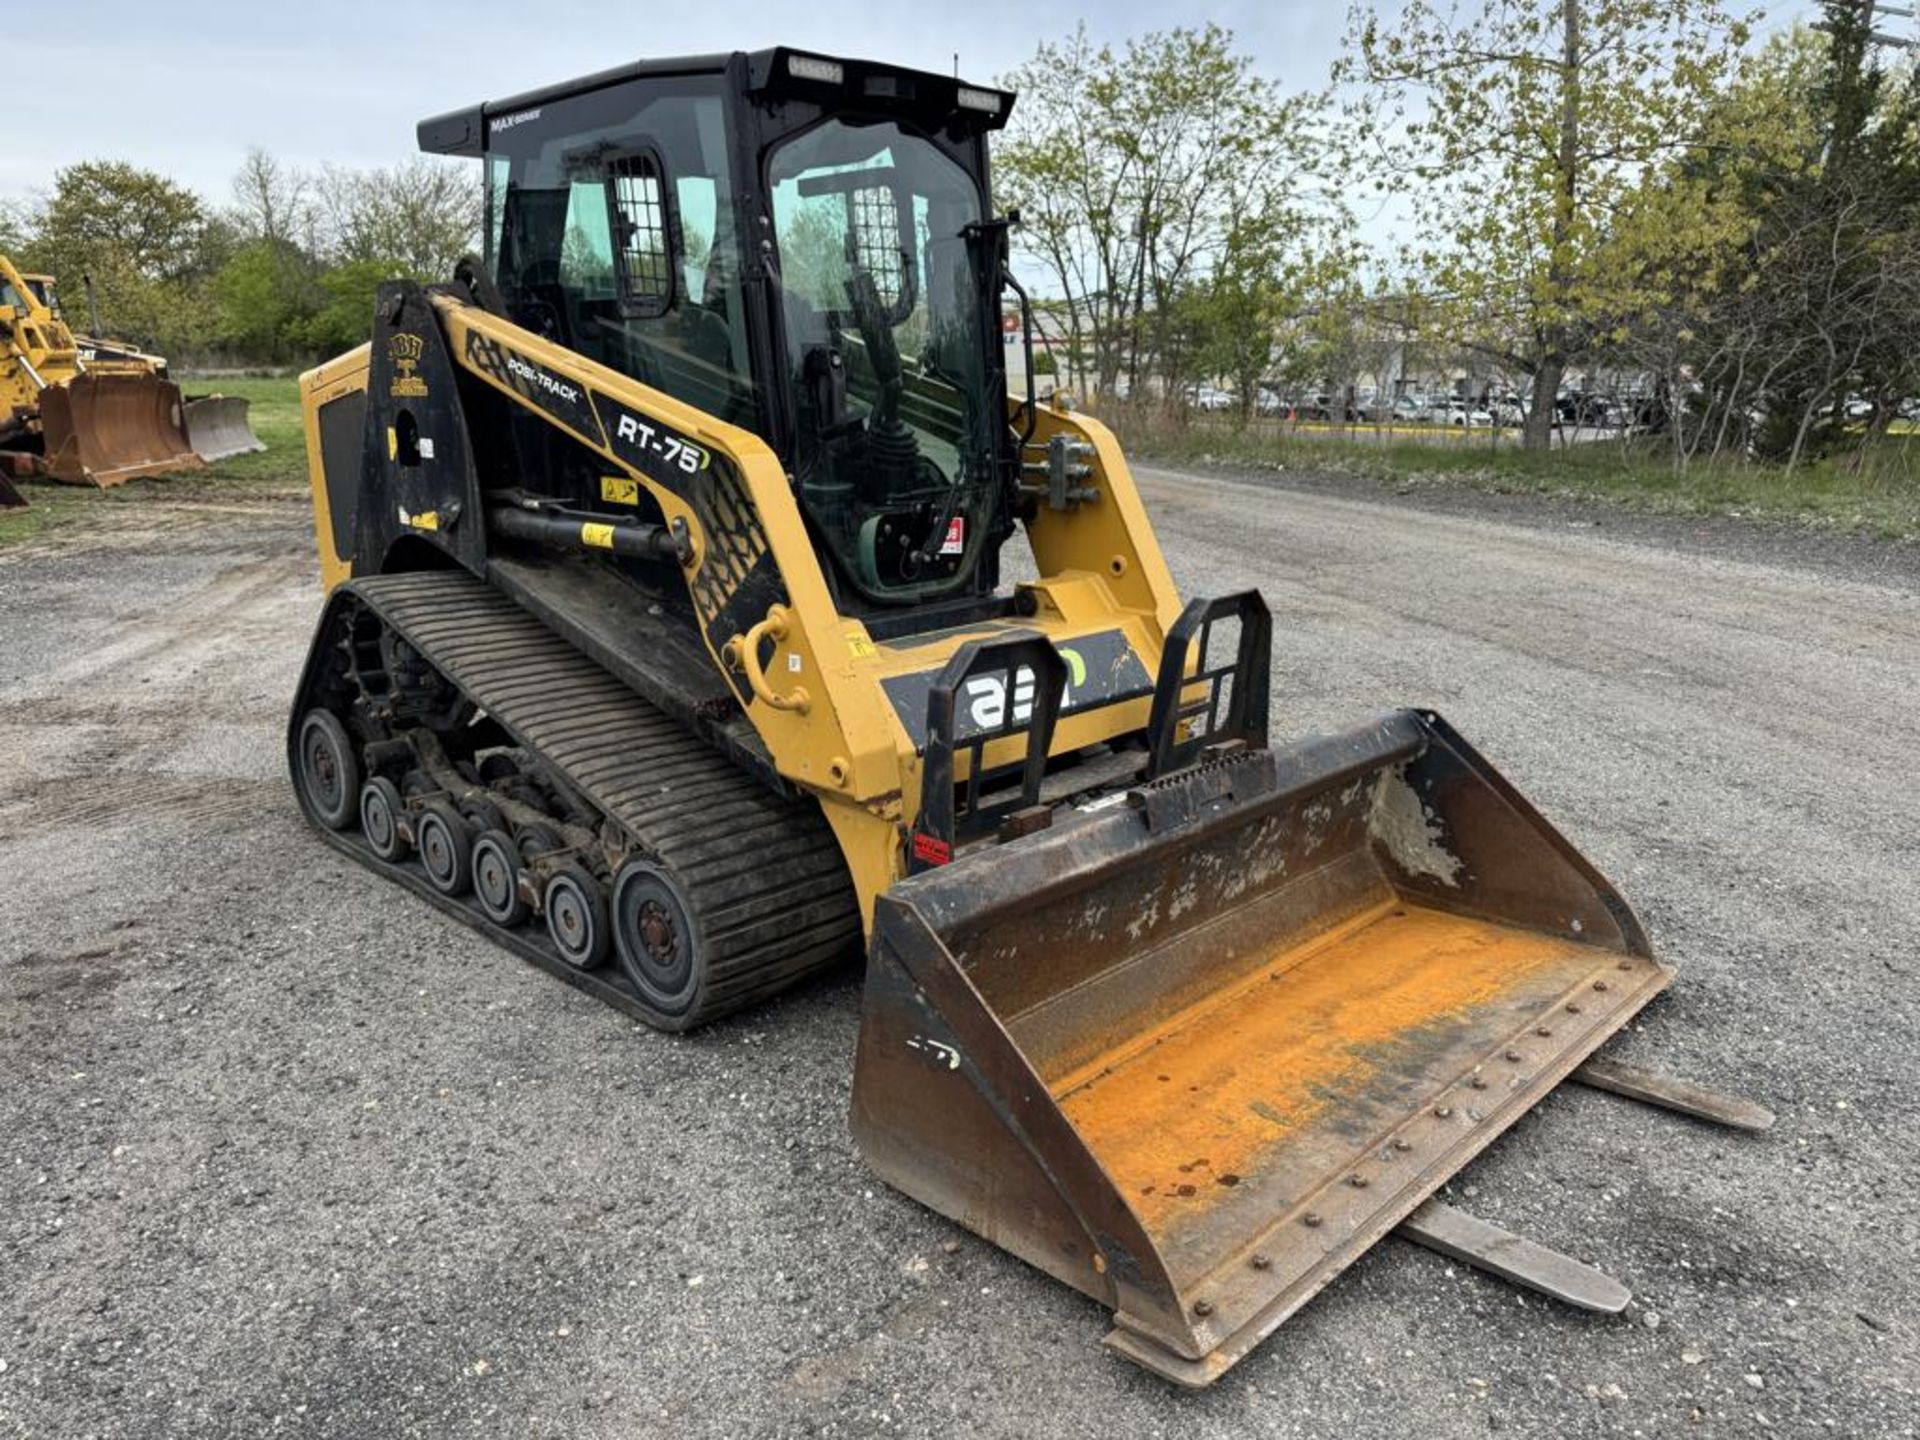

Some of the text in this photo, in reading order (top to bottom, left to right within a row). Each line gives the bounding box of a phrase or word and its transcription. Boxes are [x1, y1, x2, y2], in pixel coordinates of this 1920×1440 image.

[491, 116, 514, 133] MAX
[507, 358, 577, 403] POSI-TRACK
[618, 414, 700, 474] RT-75
